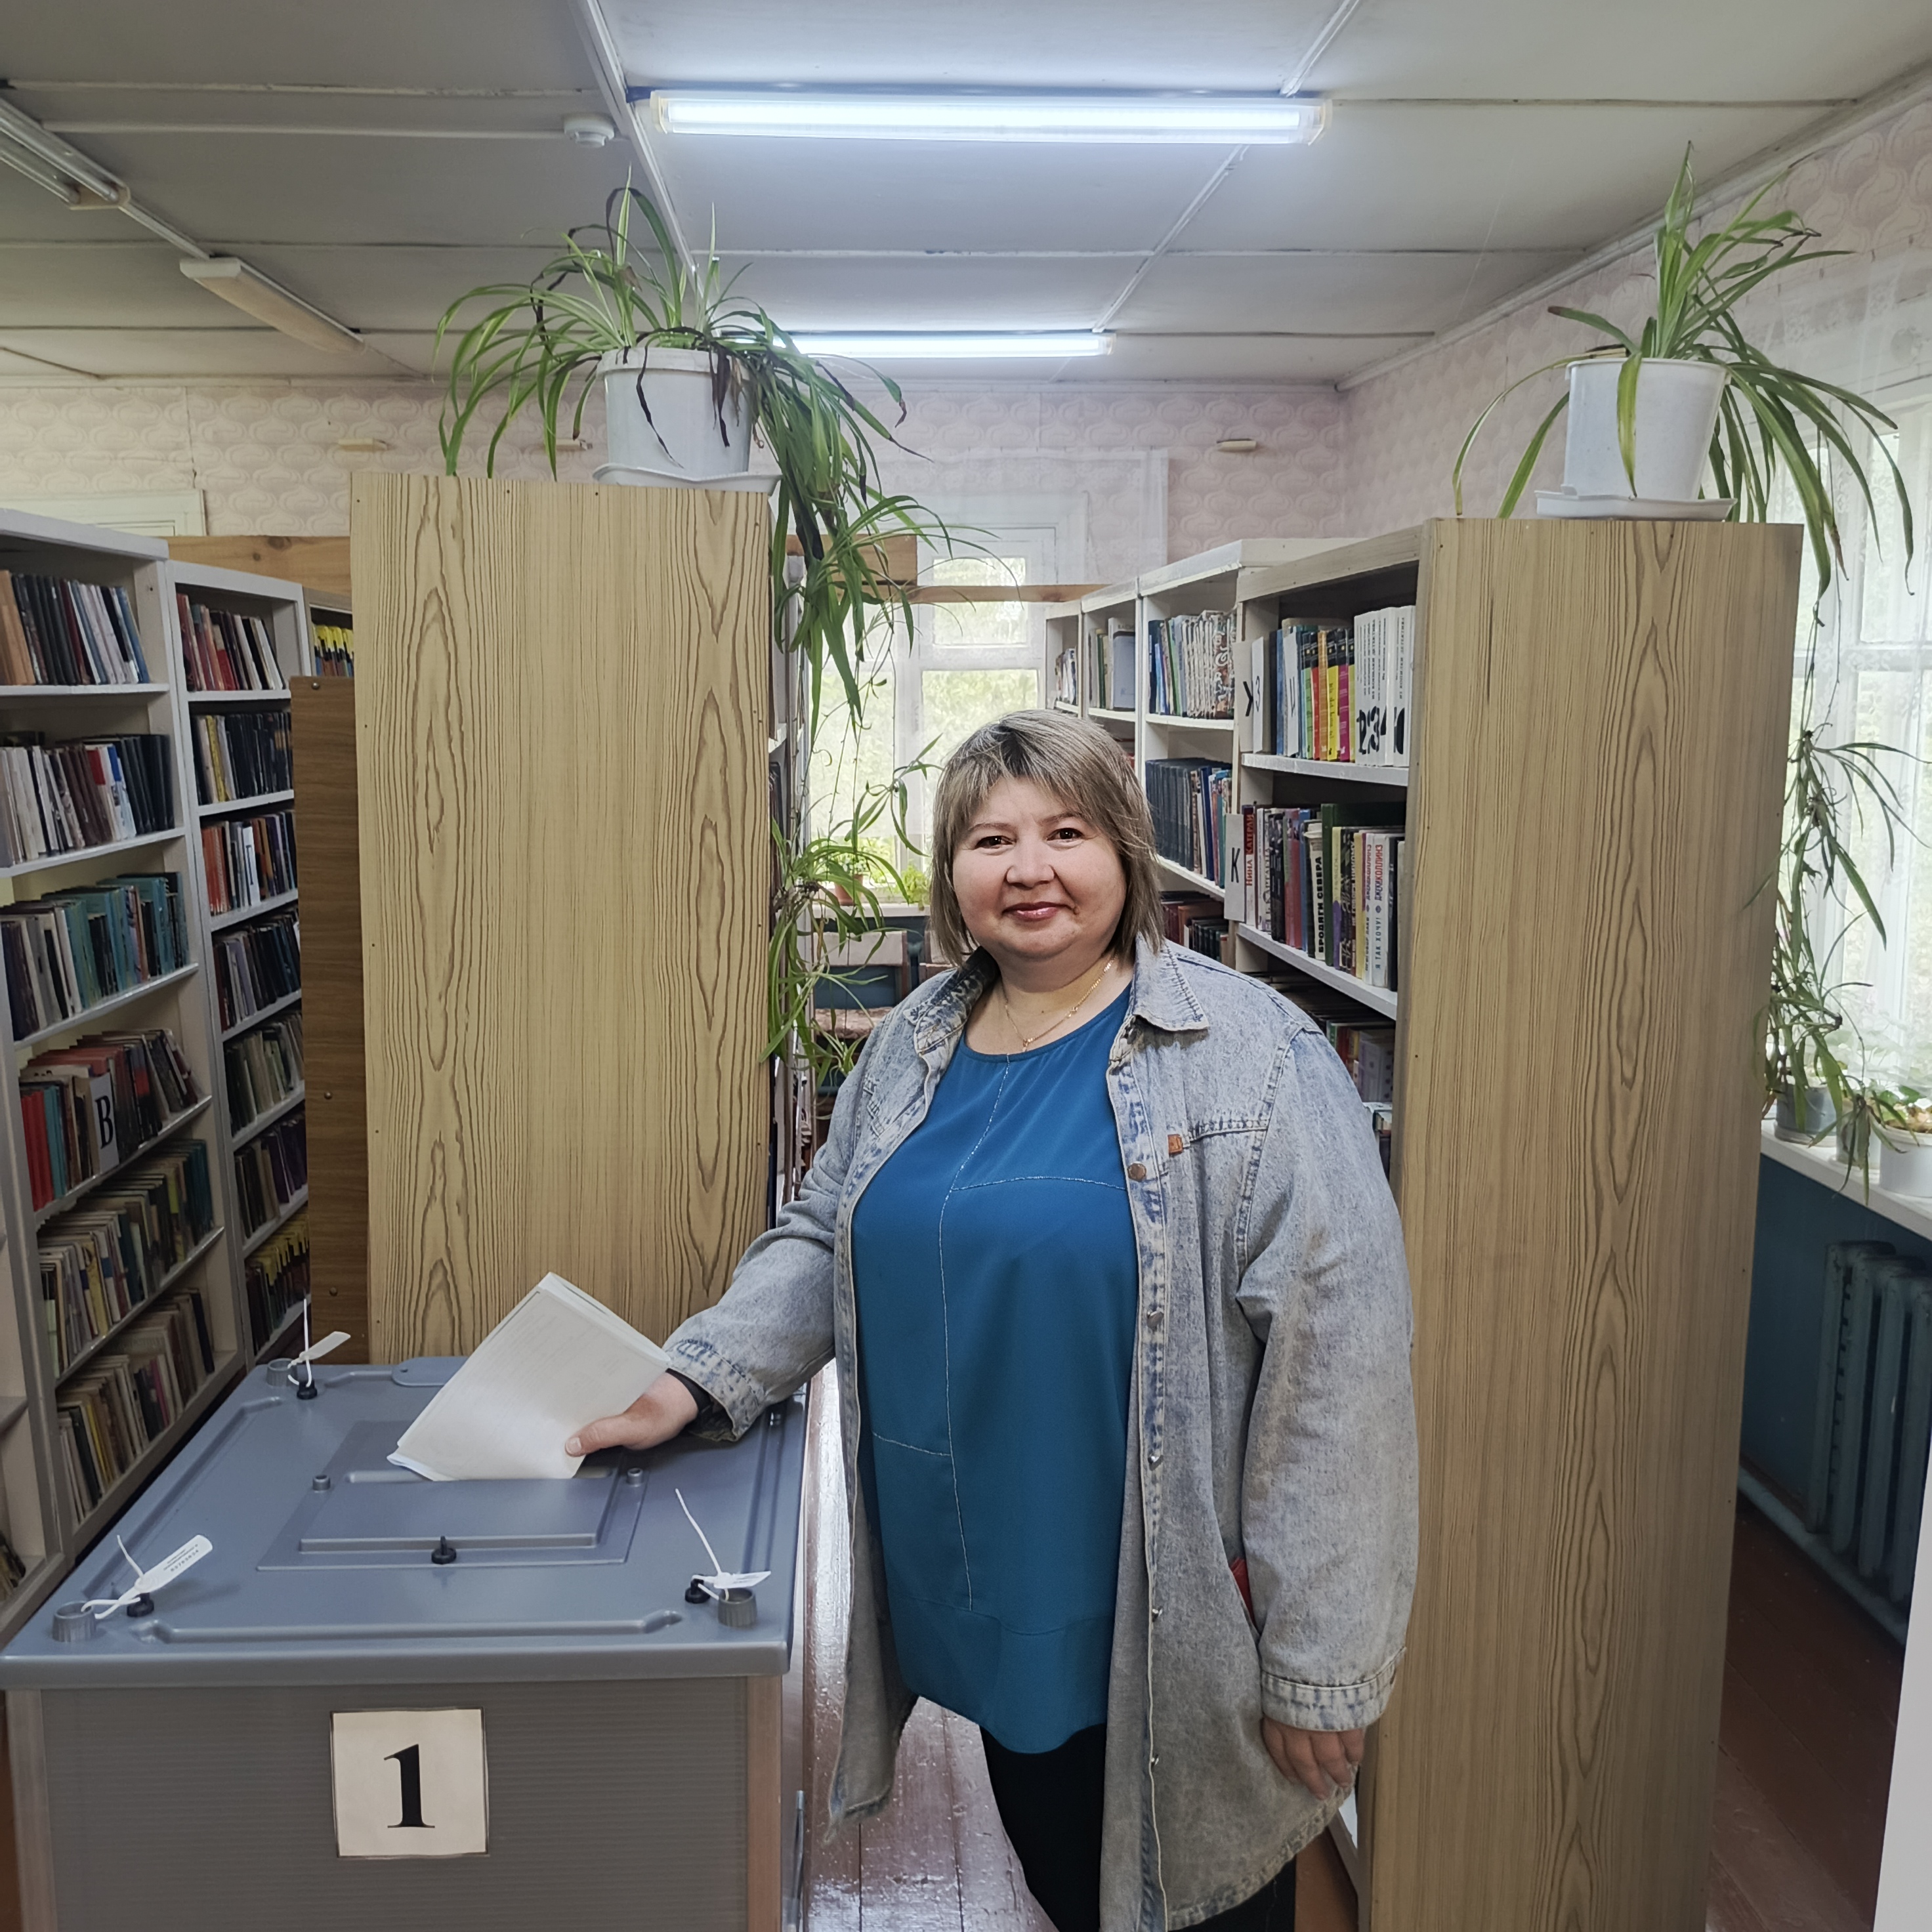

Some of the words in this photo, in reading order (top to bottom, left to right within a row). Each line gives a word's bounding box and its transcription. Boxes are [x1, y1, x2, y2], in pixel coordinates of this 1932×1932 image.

[1231, 847, 1240, 883] К
[1315, 856, 1324, 900] СЕВЕРА
[94, 1095, 114, 1150] В
[383, 1743, 436, 1829] 1
